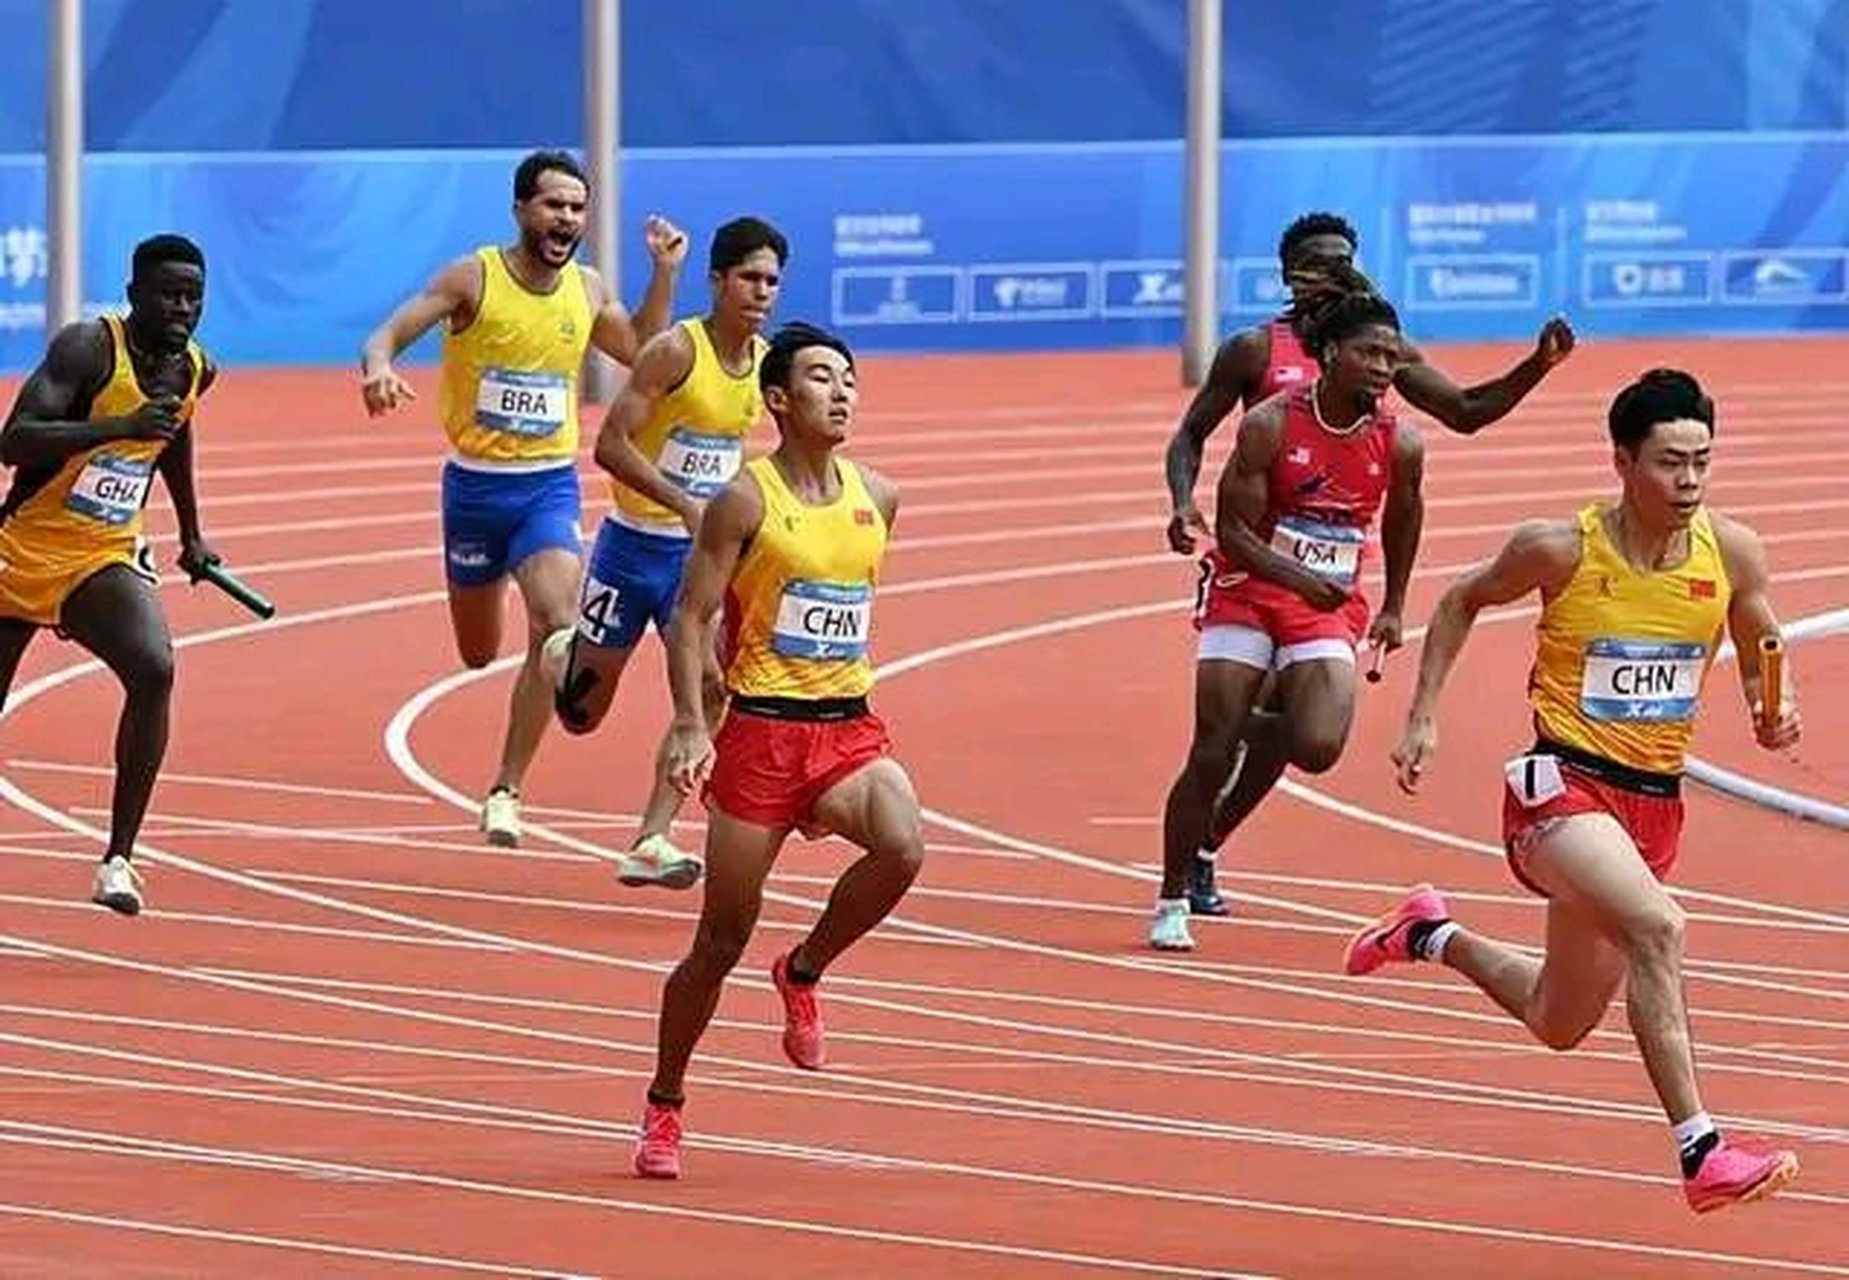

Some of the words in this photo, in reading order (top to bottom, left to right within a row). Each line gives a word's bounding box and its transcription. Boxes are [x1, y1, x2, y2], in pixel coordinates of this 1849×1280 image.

[501, 390, 547, 414] BRA
[682, 452, 722, 476] BRA
[96, 476, 138, 503] GHA
[1293, 540, 1339, 565] USA
[582, 590, 614, 636] 4
[803, 606, 861, 636] CHN
[1612, 665, 1677, 696] CHN
[1525, 759, 1536, 799] 1
